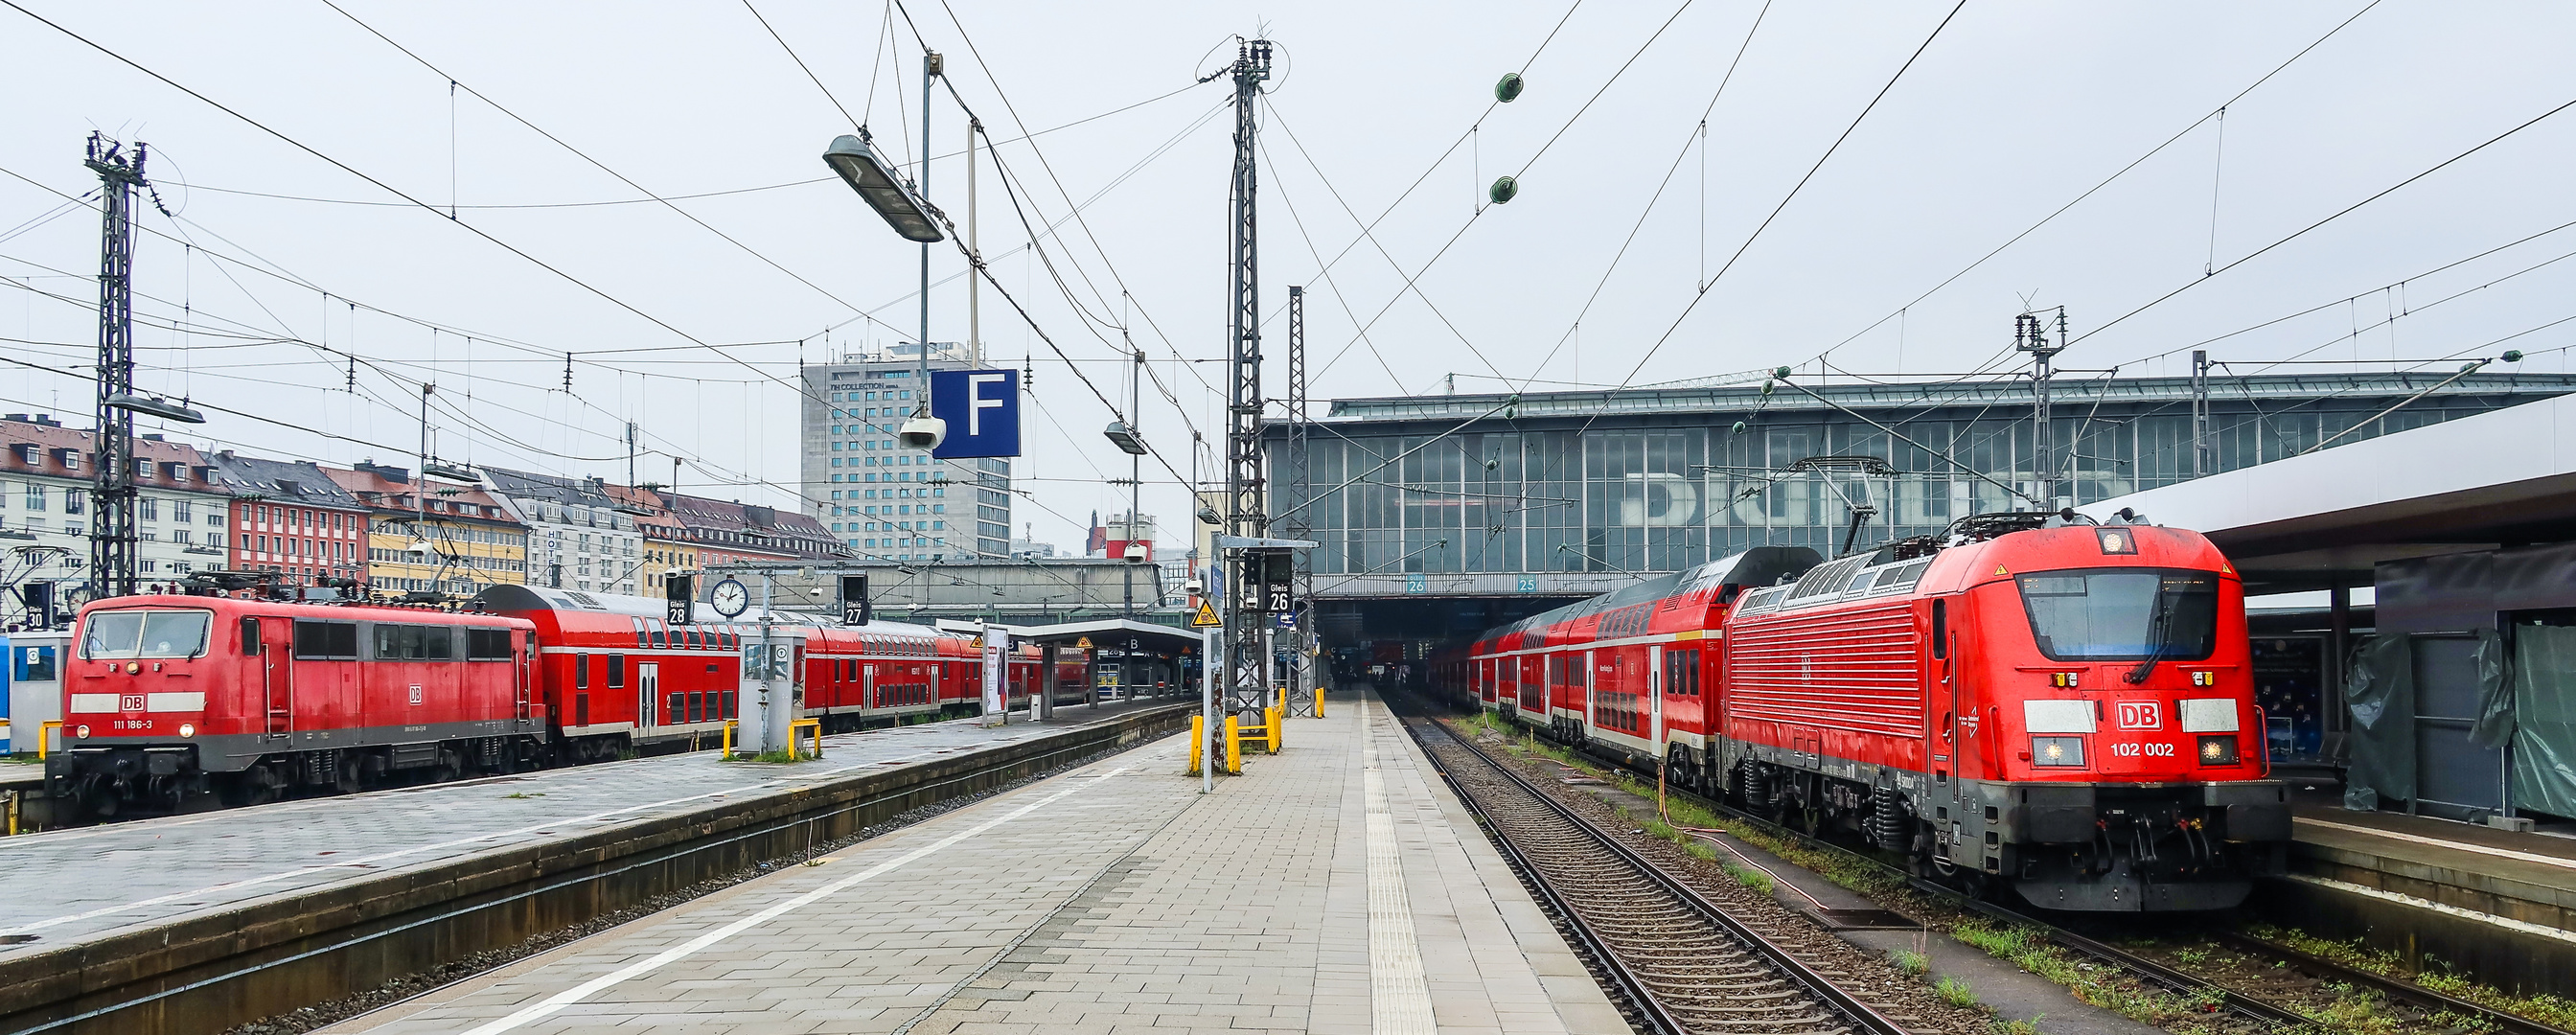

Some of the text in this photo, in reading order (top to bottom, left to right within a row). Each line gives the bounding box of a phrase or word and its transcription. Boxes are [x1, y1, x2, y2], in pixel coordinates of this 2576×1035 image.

[841, 382, 885, 391] COLLECTION
[968, 373, 1006, 436] F
[1270, 584, 1288, 592] Gleis
[1409, 581, 1424, 592] 26
[1519, 580, 1534, 591] 25
[1270, 593, 1288, 610] 26
[29, 613, 43, 627] 30
[669, 609, 685, 623] 28
[846, 609, 862, 624] 27
[1131, 639, 1138, 650] B
[410, 687, 422, 702] DB
[124, 697, 143, 709] DB
[666, 695, 671, 709] 2
[2121, 704, 2157, 726] DB
[113, 720, 152, 729] 111 186-3
[2110, 743, 2175, 757] 102 002
